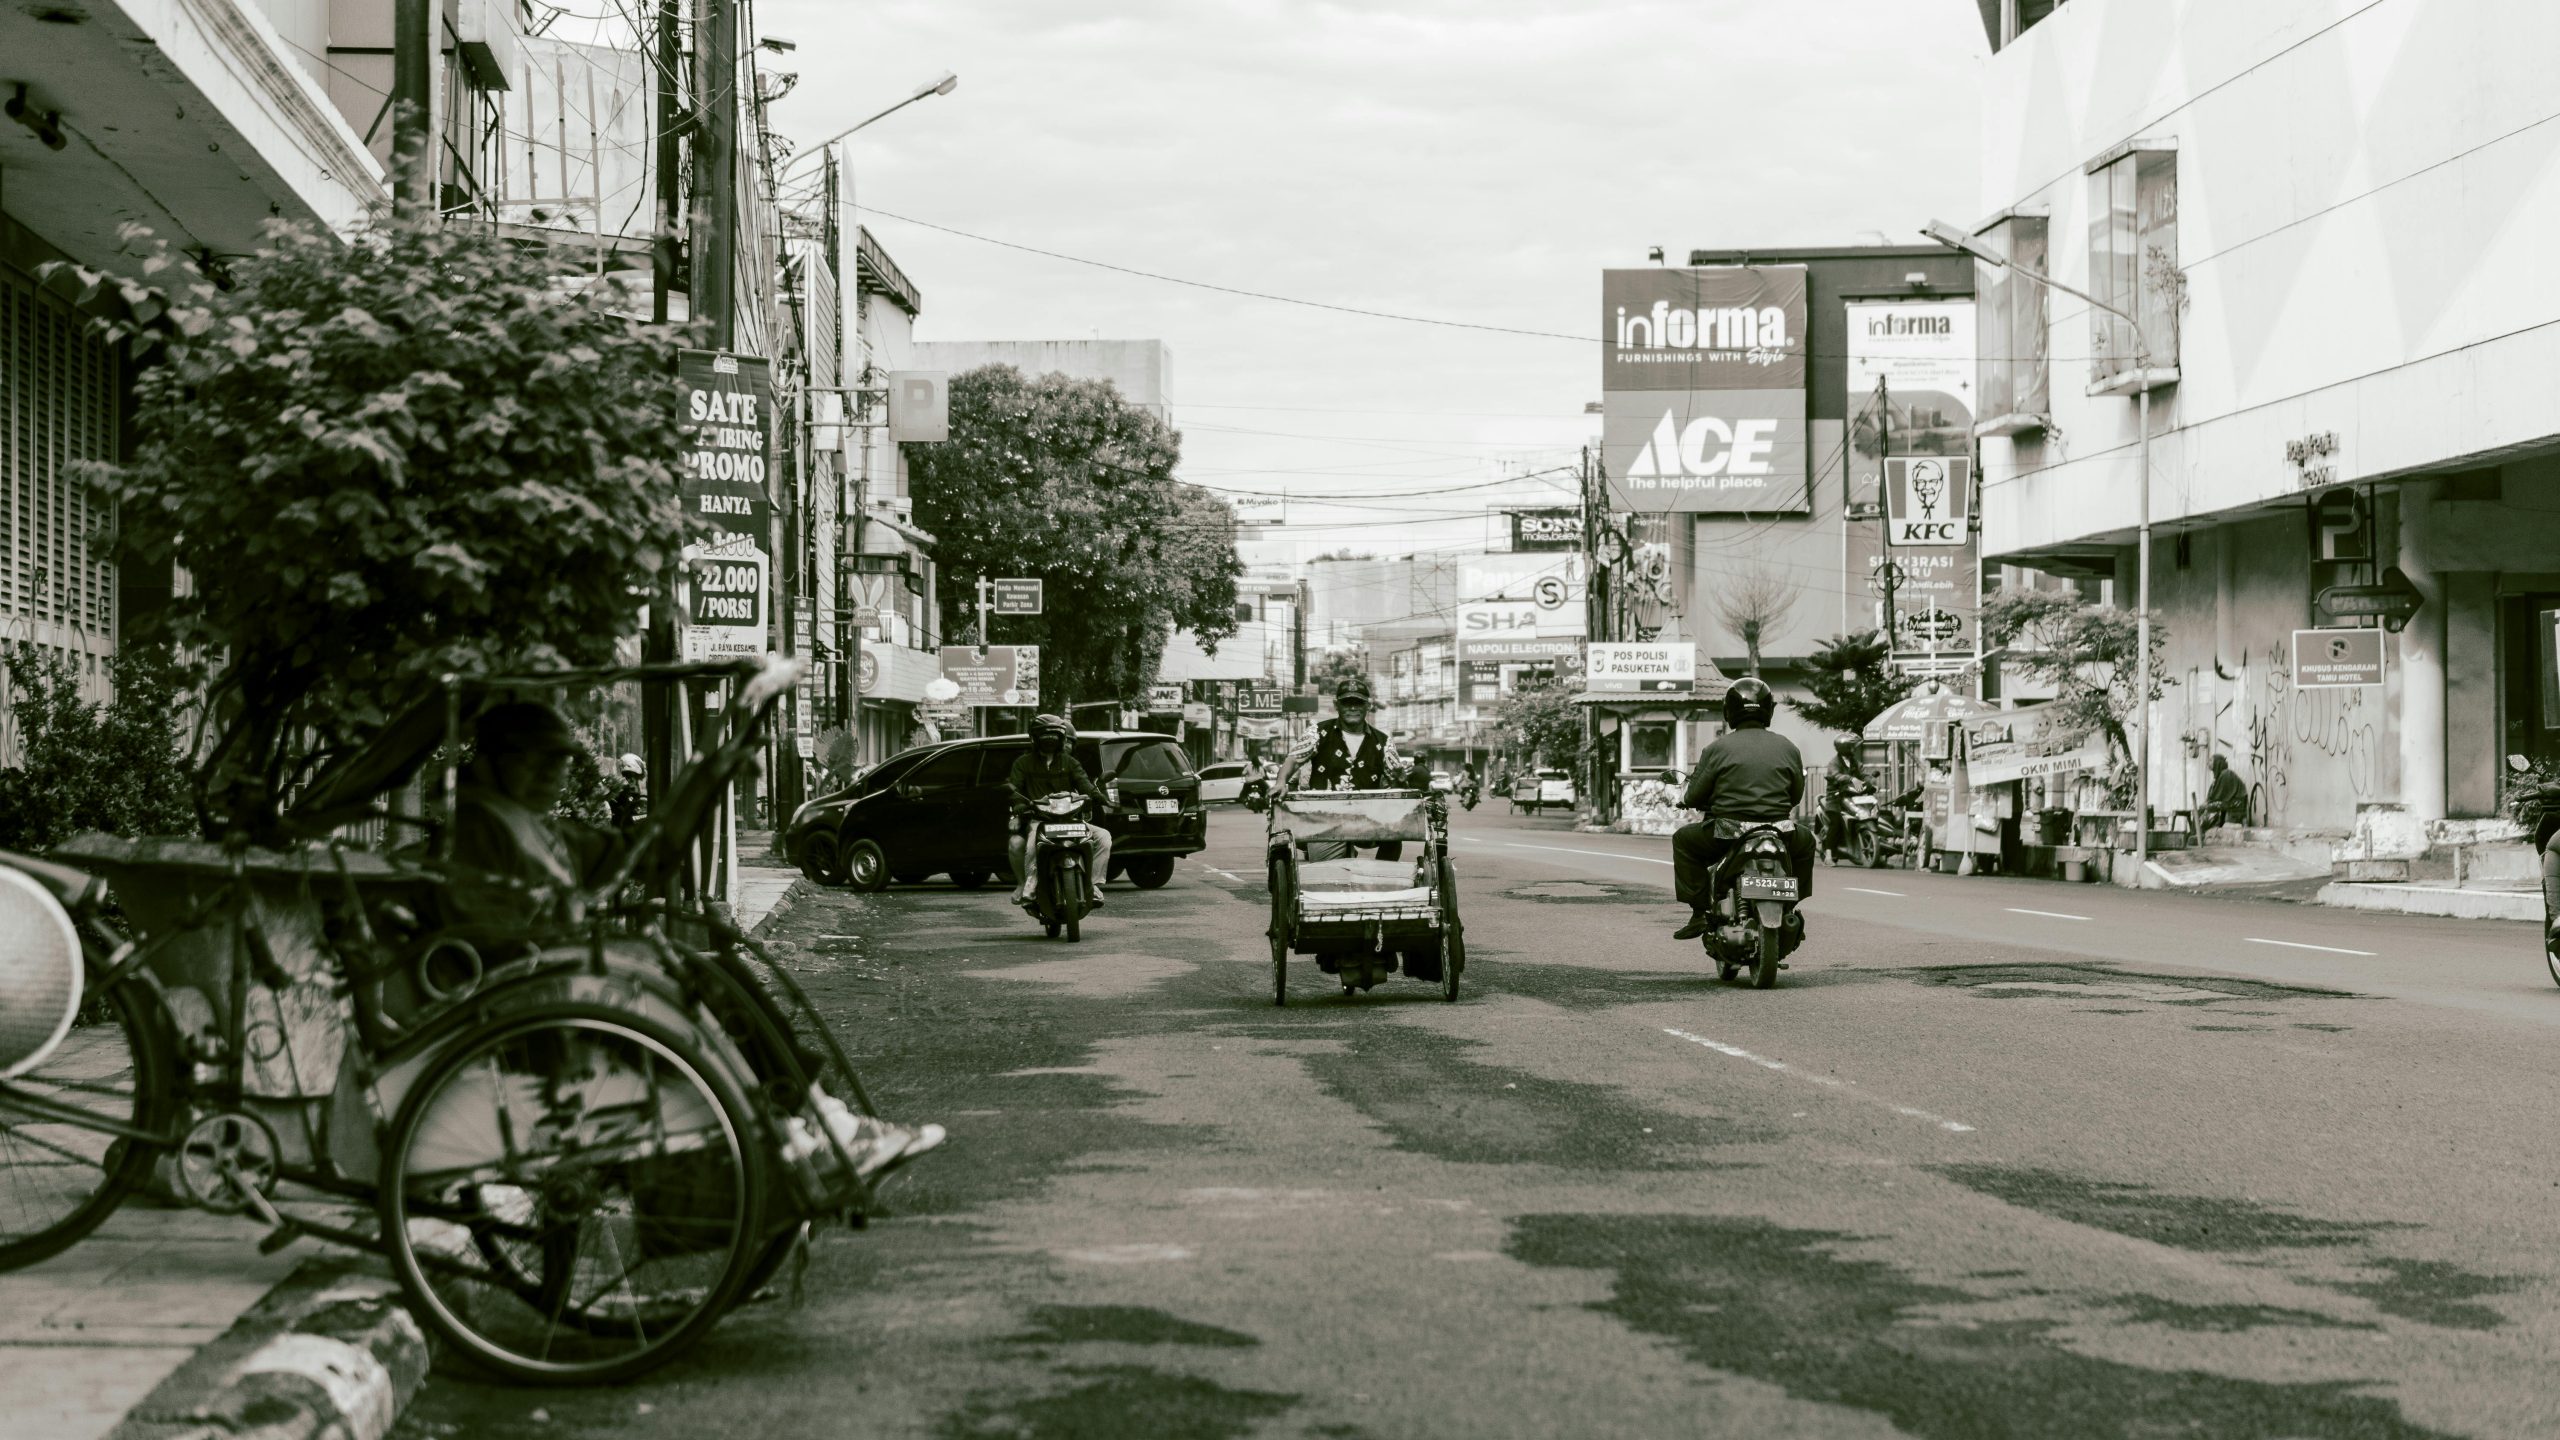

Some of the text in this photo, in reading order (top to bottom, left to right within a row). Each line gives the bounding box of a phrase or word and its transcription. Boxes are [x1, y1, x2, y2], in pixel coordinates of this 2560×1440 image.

[1617, 301, 1786, 349] informa
[1868, 313, 1950, 336] informa
[1617, 346, 1787, 367] FURNISHINGS WITH Style
[690, 389, 758, 425] SATE
[1627, 408, 1778, 476] ACE
[683, 451, 765, 483] PROMO
[1627, 477, 1767, 490] The helpful place.
[700, 495, 752, 515] HANYA
[1520, 519, 1584, 533] SONY
[1903, 523, 1954, 540] KFC
[701, 565, 758, 594] 22.000
[857, 610, 876, 620] pink
[1468, 644, 1509, 654] NAPOLI
[1614, 651, 1668, 660] POS POLISI
[1612, 664, 1669, 673] PASUKETAN
[2302, 663, 2377, 673] KHUSUS KENDARAAN
[2317, 673, 2362, 682] TAMU HOTEL
[1153, 690, 1177, 701] JNE
[1255, 693, 1282, 708] ME
[2021, 758, 2081, 775] OKM MIMI
[1755, 879, 1777, 888] 5234
